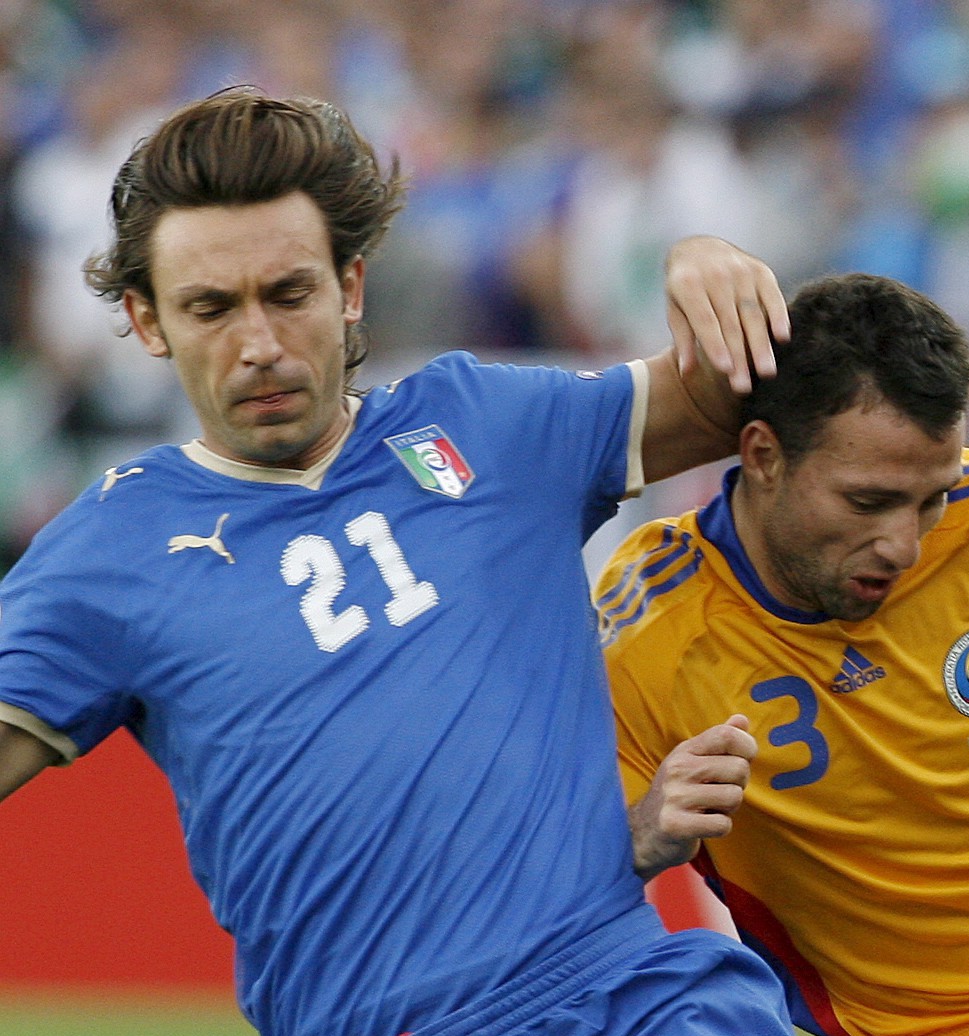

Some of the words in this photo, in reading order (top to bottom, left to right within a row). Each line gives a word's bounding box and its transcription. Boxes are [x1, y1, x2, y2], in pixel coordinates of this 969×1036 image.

[280, 511, 440, 653] 21
[751, 676, 829, 790] 3
[831, 665, 887, 694] adidas
